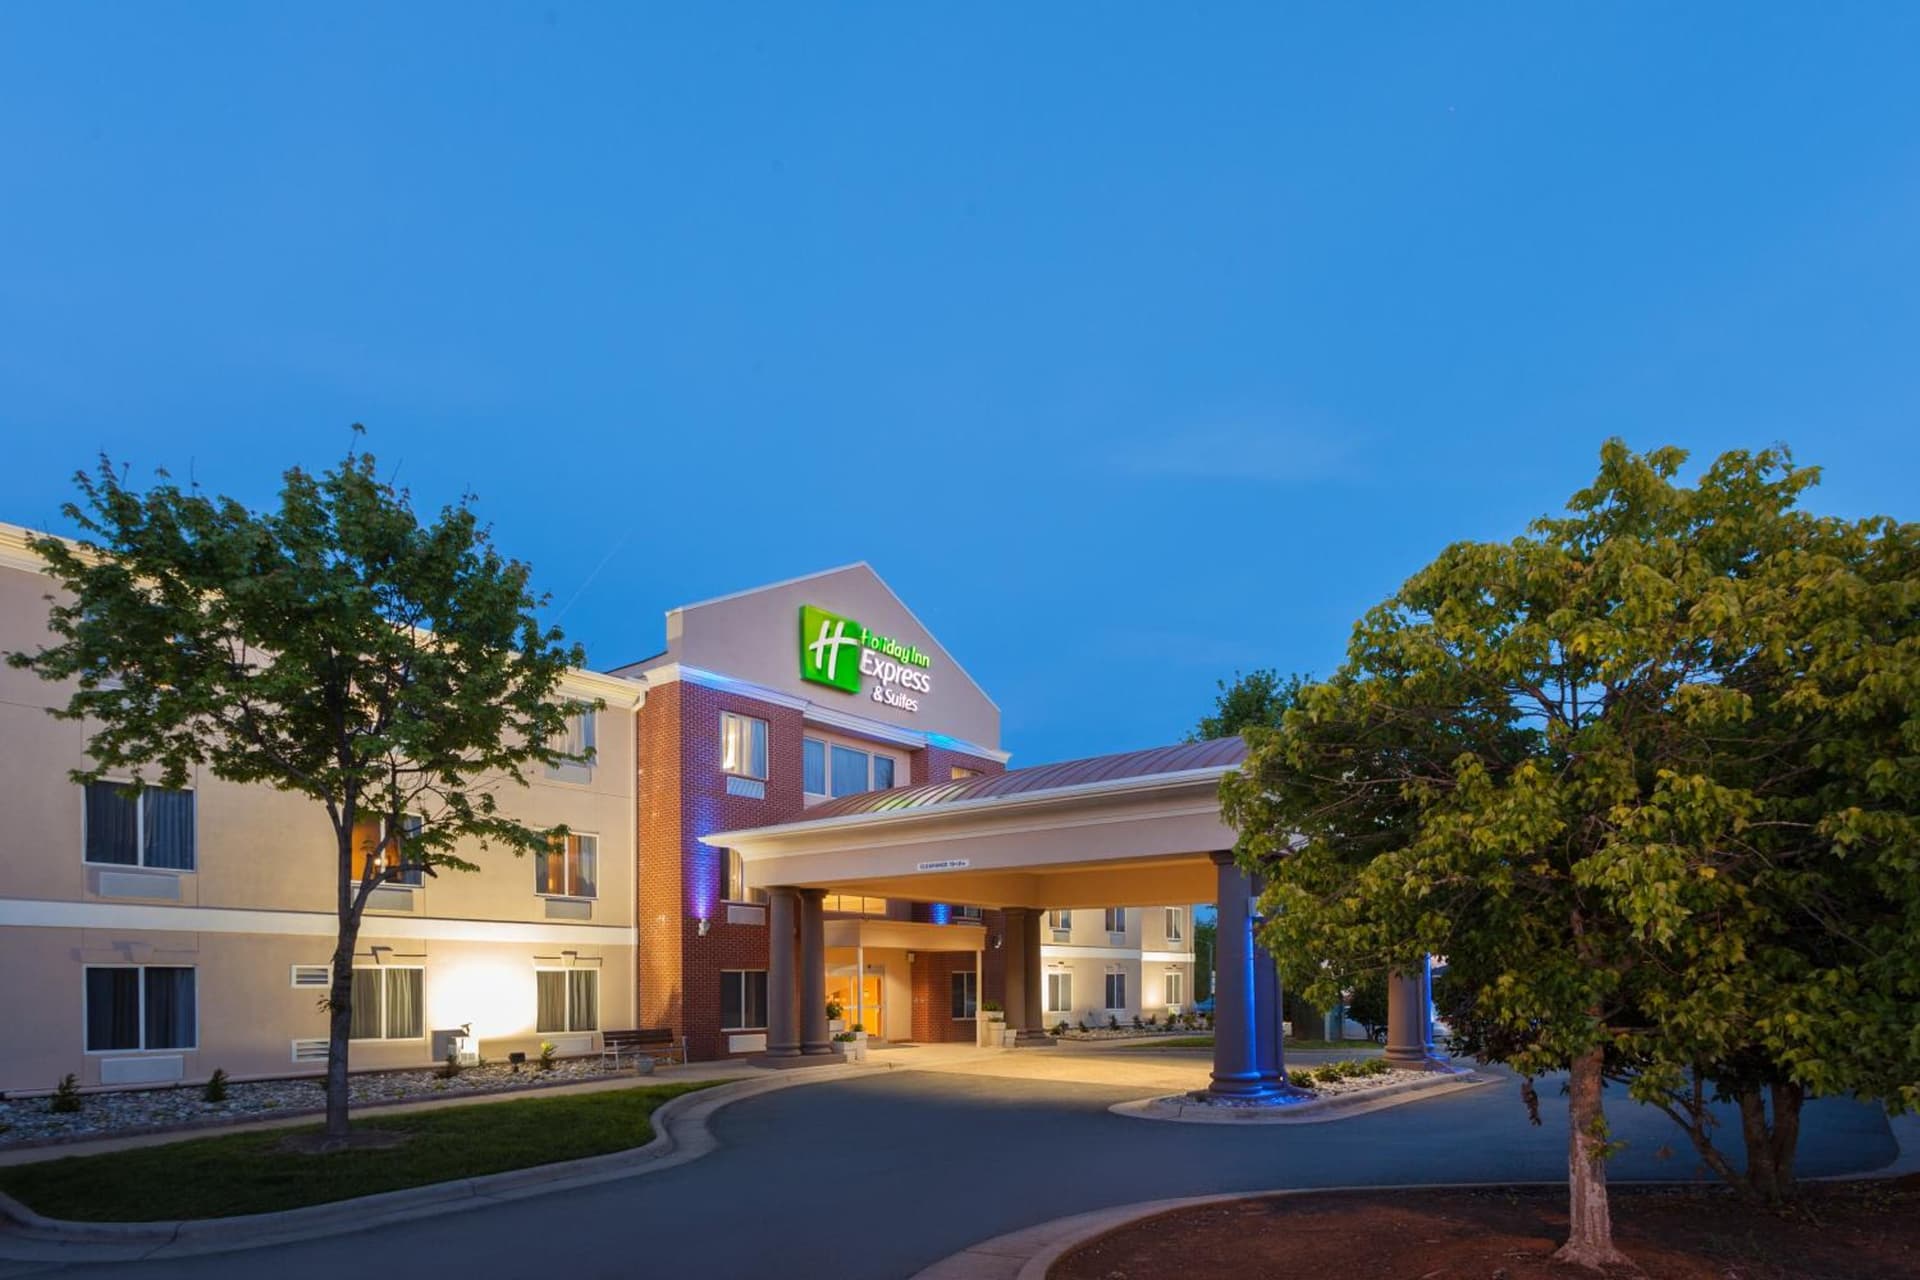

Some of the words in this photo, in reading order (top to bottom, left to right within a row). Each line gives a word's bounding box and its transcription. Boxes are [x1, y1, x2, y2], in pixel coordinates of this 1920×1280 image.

[861, 627, 911, 664] Holiday
[911, 645, 930, 668] Inn
[860, 648, 930, 693] Express
[873, 686, 883, 702] &
[884, 688, 918, 712] Suites
